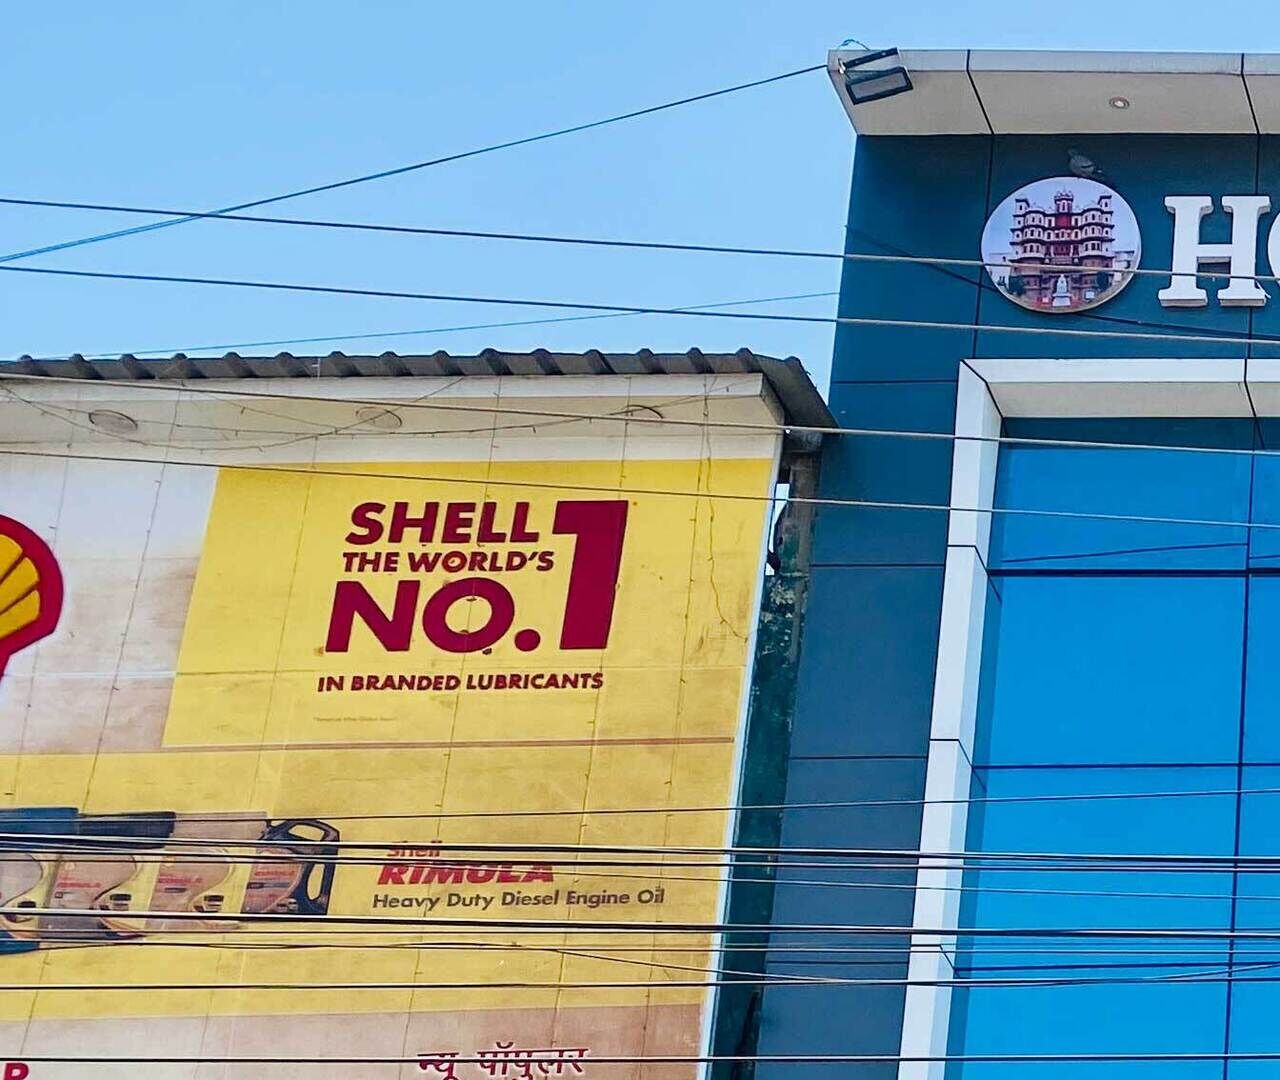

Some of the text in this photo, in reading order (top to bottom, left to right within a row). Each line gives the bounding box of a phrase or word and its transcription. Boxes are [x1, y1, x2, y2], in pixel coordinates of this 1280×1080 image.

[345, 500, 540, 546] SHELL
[342, 551, 400, 573] THE
[325, 499, 629, 654] NO. 1
[317, 672, 604, 693] IN BRANDED LUBRICANTS
[372, 886, 664, 911] Heavy Duty Diesel Engine Oil
